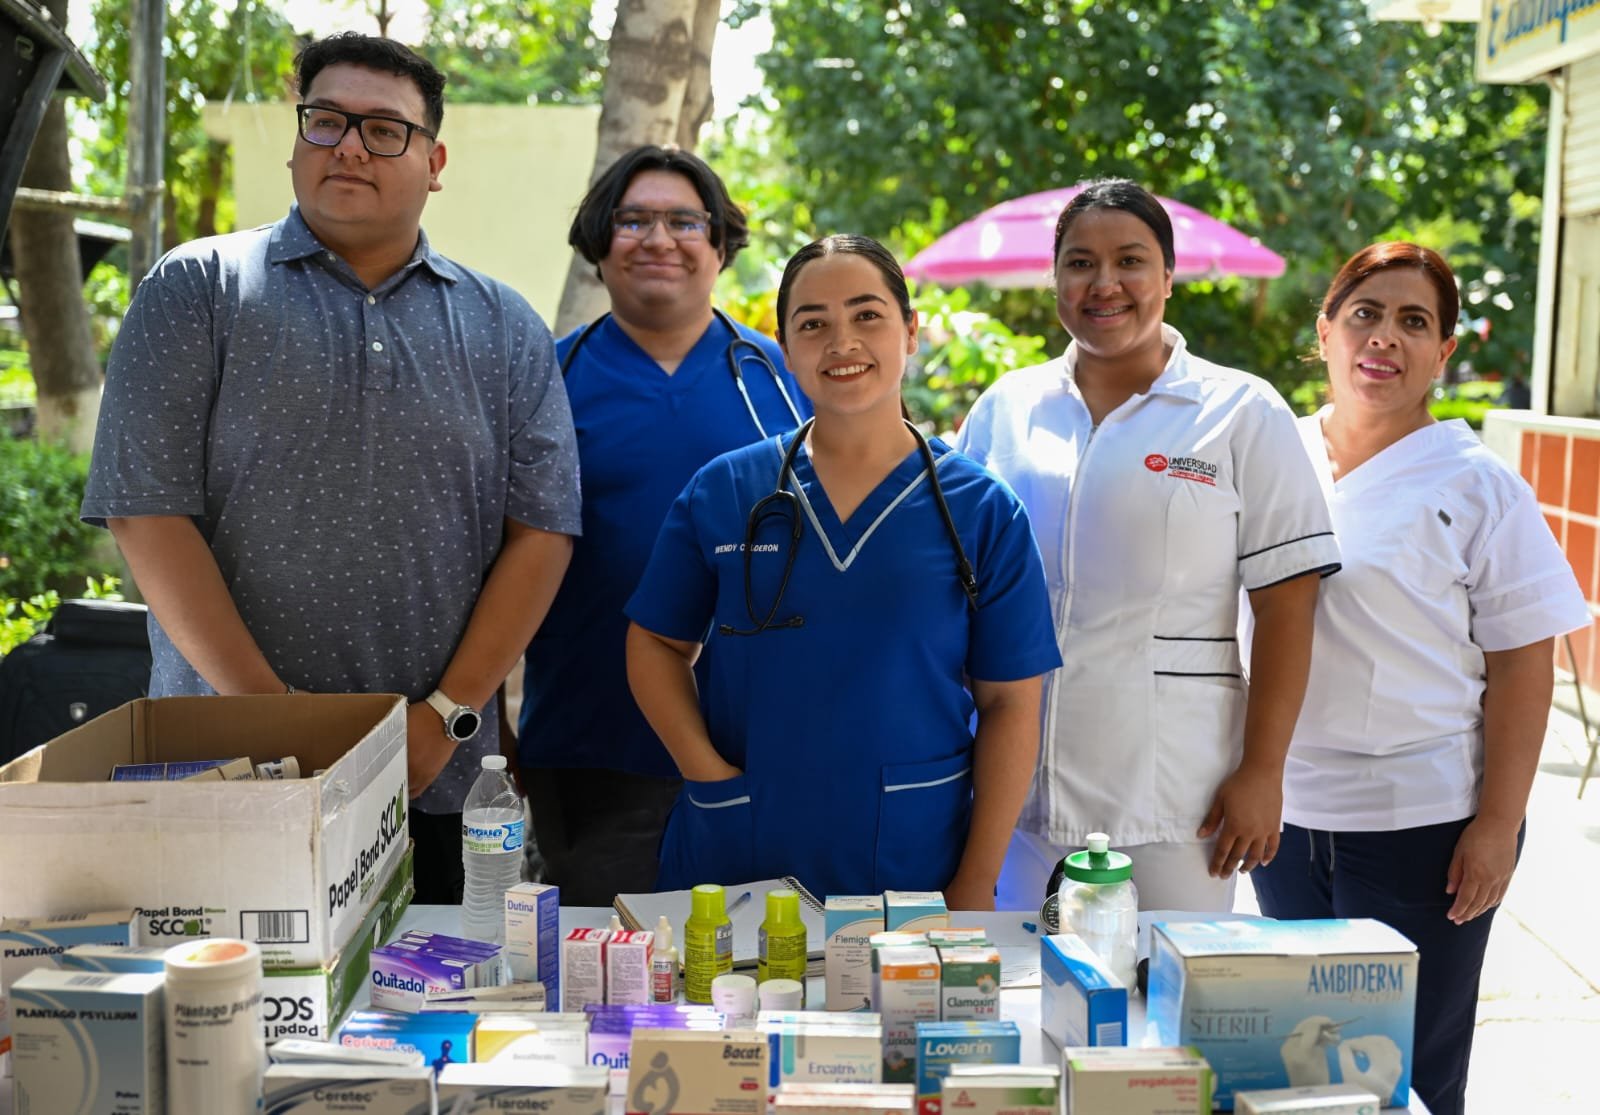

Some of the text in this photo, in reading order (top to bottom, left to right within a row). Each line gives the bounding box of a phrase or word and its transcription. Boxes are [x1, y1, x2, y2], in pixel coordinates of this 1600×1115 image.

[1168, 457, 1217, 474] UNIVERSIDAD
[715, 543, 779, 554] WENDY CLDERON
[329, 858, 358, 918] Papel
[360, 829, 380, 881] Bond
[172, 906, 203, 917] Bond
[507, 900, 534, 913] Dutina
[5, 946, 65, 958] PLANTAGO
[372, 970, 425, 994] Quitadol
[1308, 962, 1403, 993] AMBIDERM
[947, 996, 994, 1008] Clamoxin
[16, 1008, 138, 1020] PLANTAGO PSYLLIUM
[274, 1023, 318, 1038] Papel
[1190, 1015, 1274, 1035] STERILE
[925, 1040, 993, 1057] Lovarin
[313, 1090, 373, 1103] Ceretec
